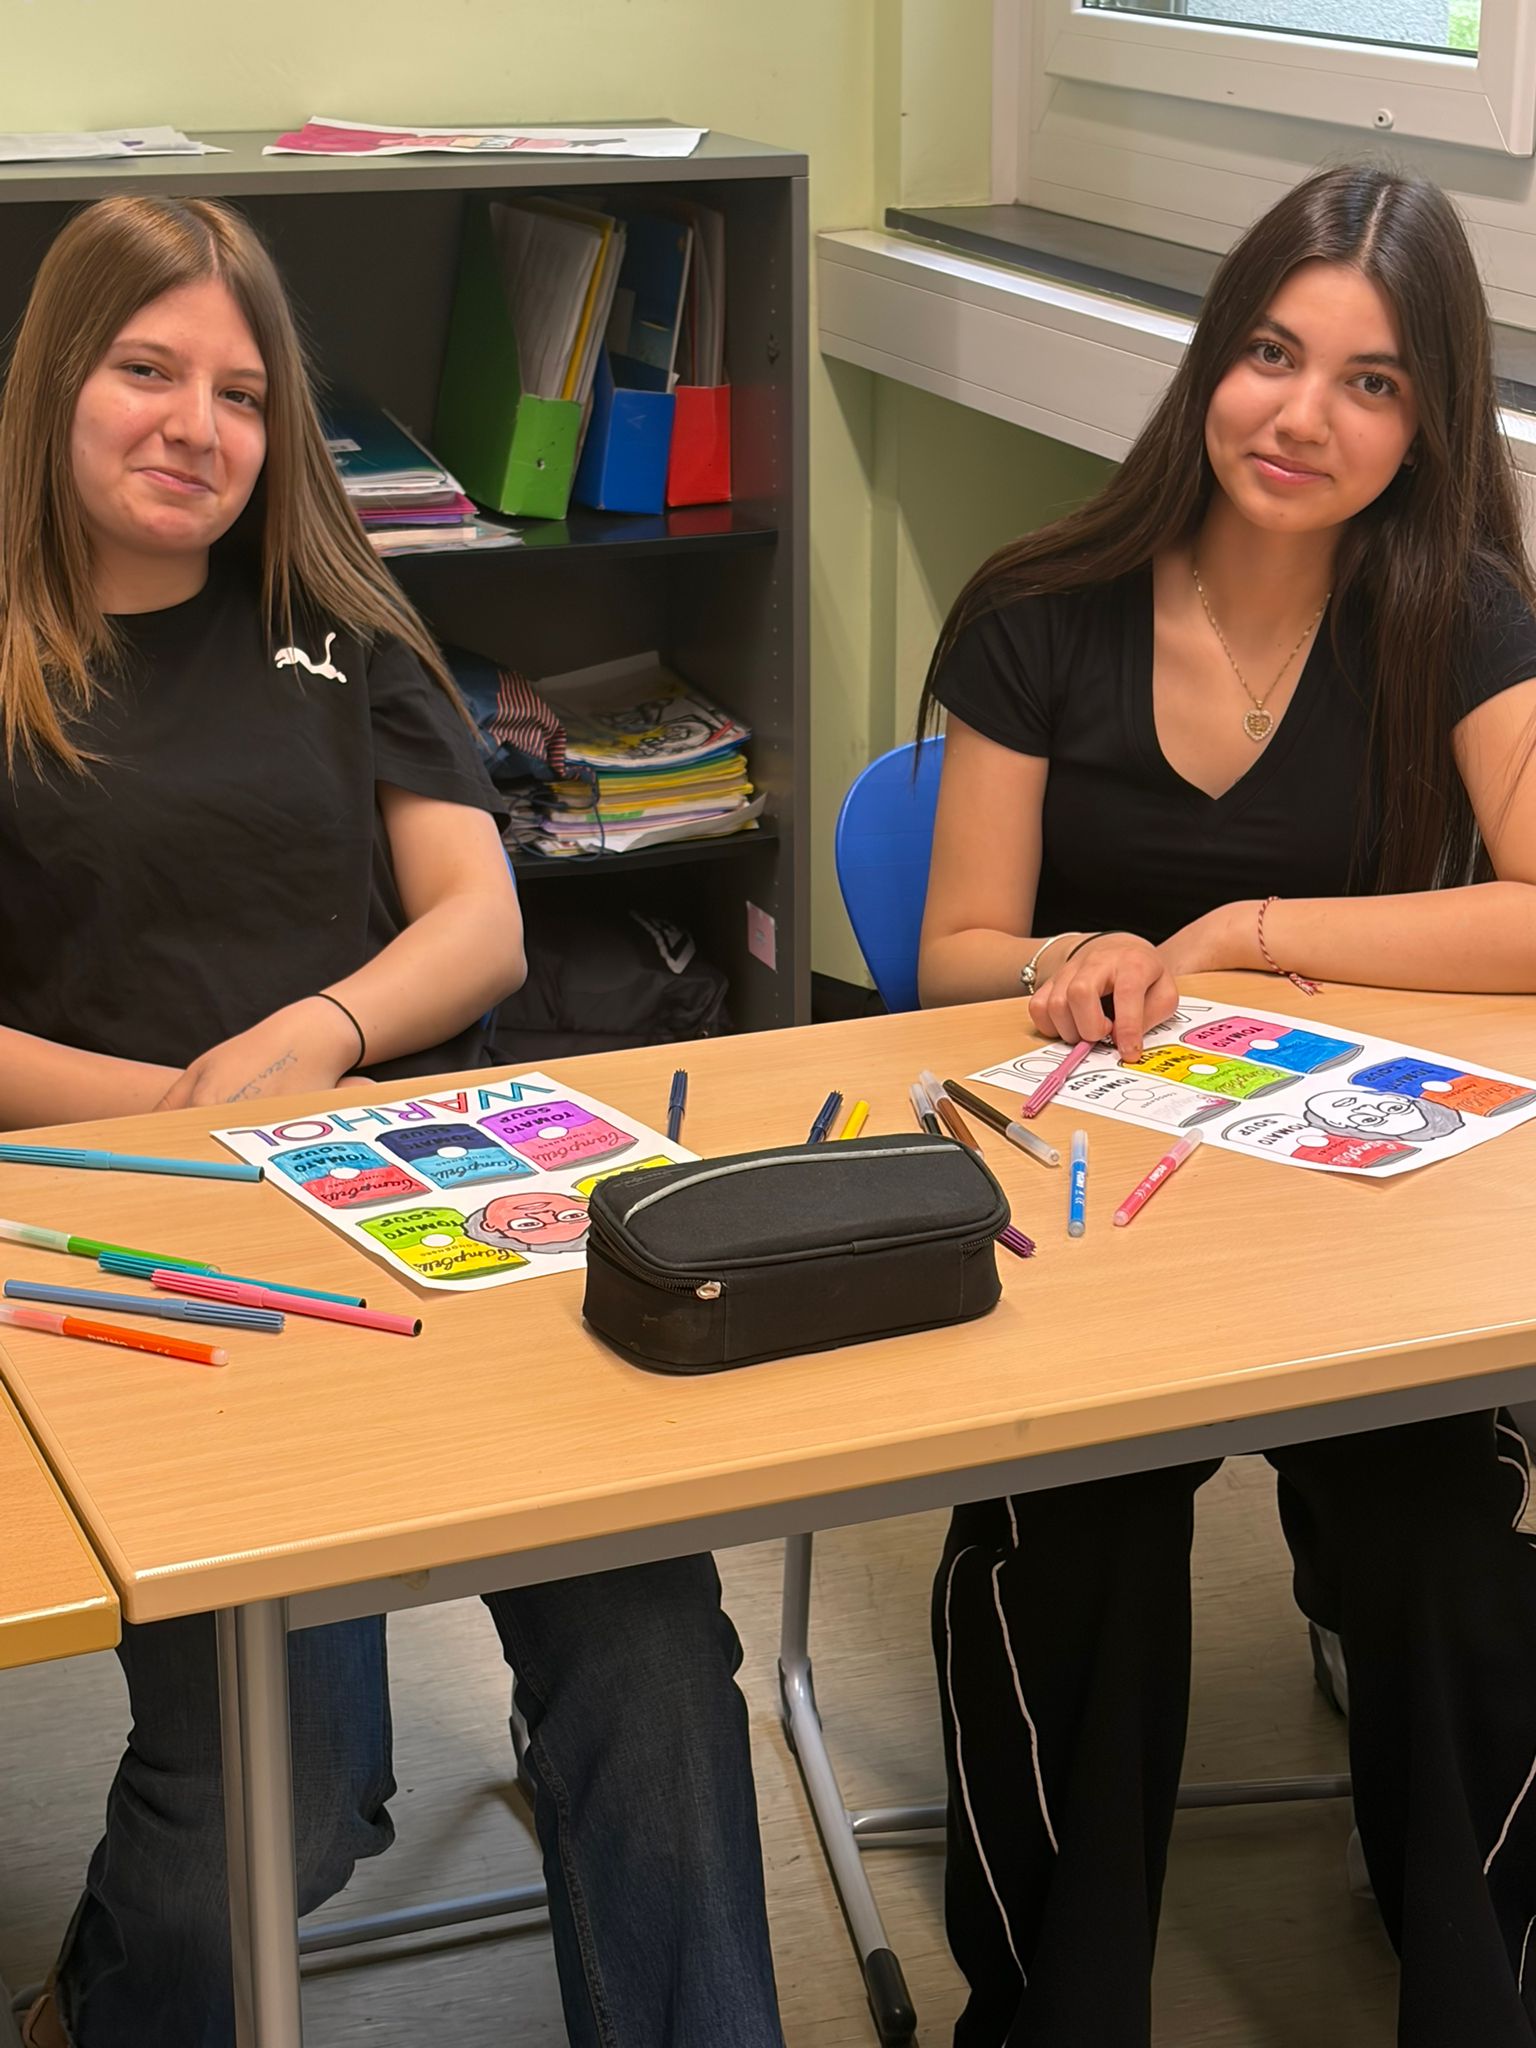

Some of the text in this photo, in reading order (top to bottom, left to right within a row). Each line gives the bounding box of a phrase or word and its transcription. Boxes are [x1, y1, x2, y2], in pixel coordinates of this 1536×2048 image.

[1195, 1023, 1233, 1040] SOUP
[1212, 1026, 1264, 1048] TOMATO
[1151, 1053, 1204, 1074] TOMATO
[1068, 1074, 1107, 1091] SOUP
[1085, 1077, 1140, 1100] TOMATO
[227, 1082, 556, 1147] WARHOL
[499, 1107, 551, 1123] SOUP
[503, 1111, 574, 1134] TOMATO
[1239, 1118, 1278, 1136] SOUP
[1257, 1123, 1308, 1145] TOMATO
[291, 1145, 347, 1160] SOUP
[294, 1153, 369, 1172] TOMATO
[379, 1211, 437, 1227] SOUP
[383, 1219, 462, 1240] TOMATO
